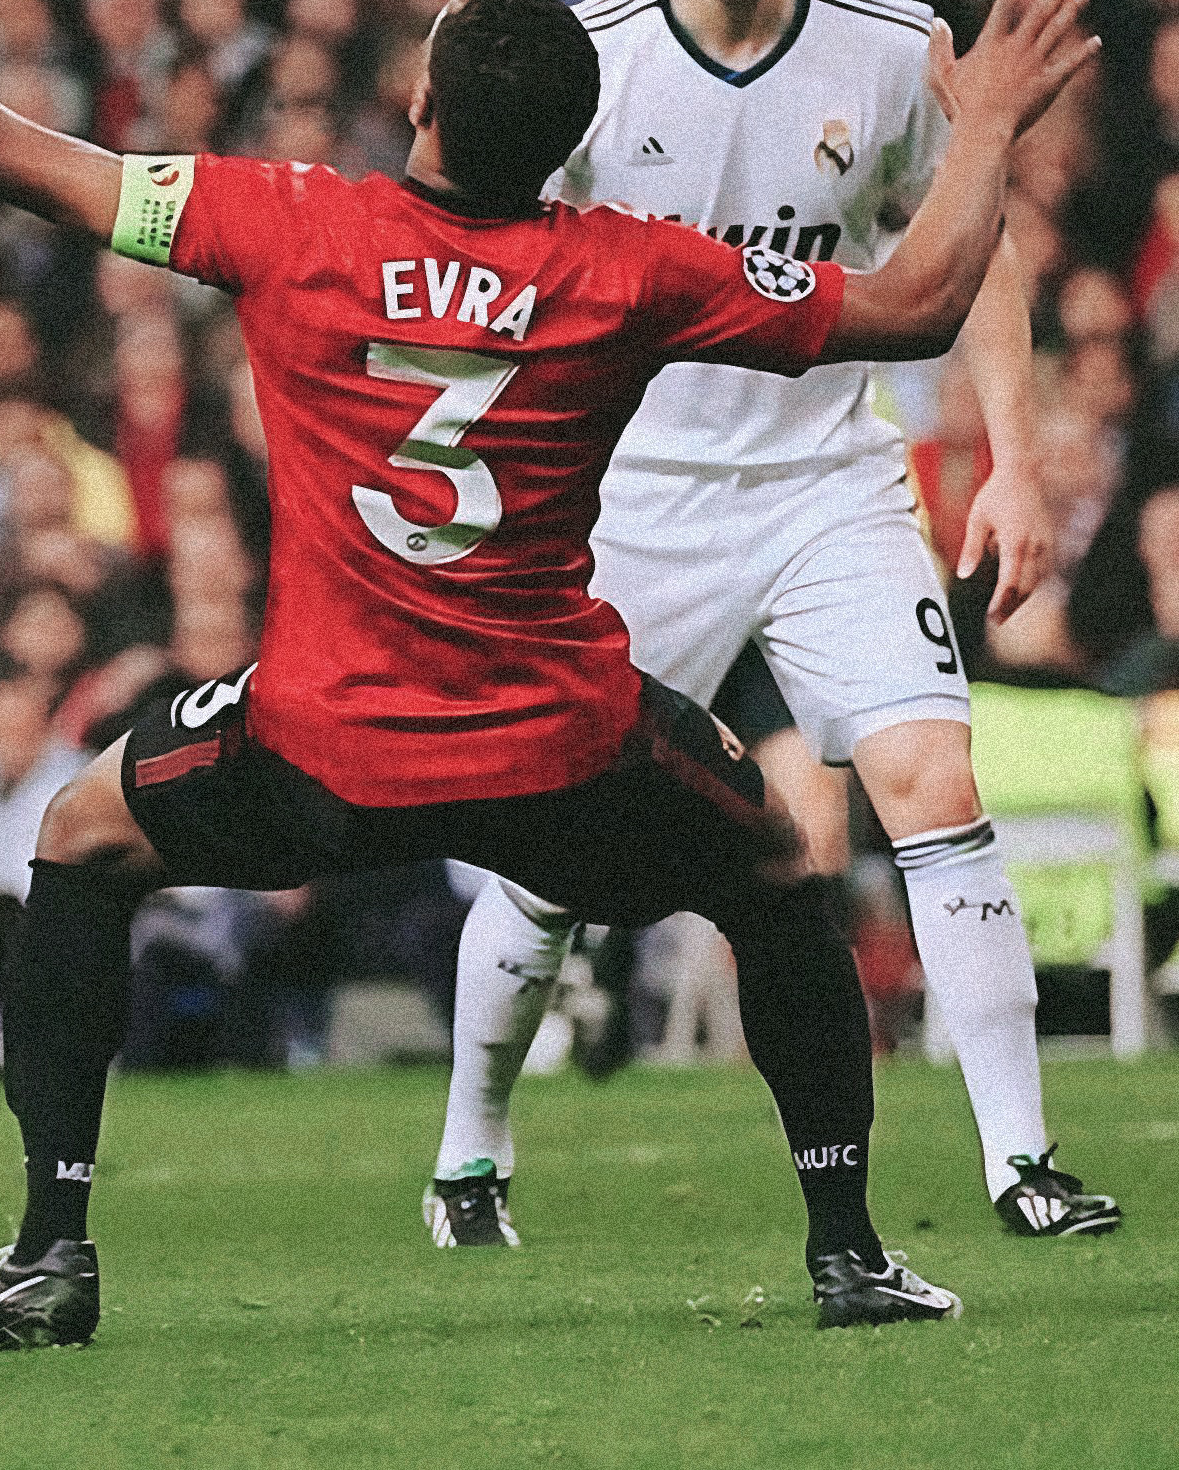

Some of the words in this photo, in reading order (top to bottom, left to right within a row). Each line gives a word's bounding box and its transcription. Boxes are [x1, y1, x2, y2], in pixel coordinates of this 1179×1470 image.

[381, 257, 538, 341] EVRA
[351, 341, 521, 565] 3
[915, 597, 958, 675] 9
